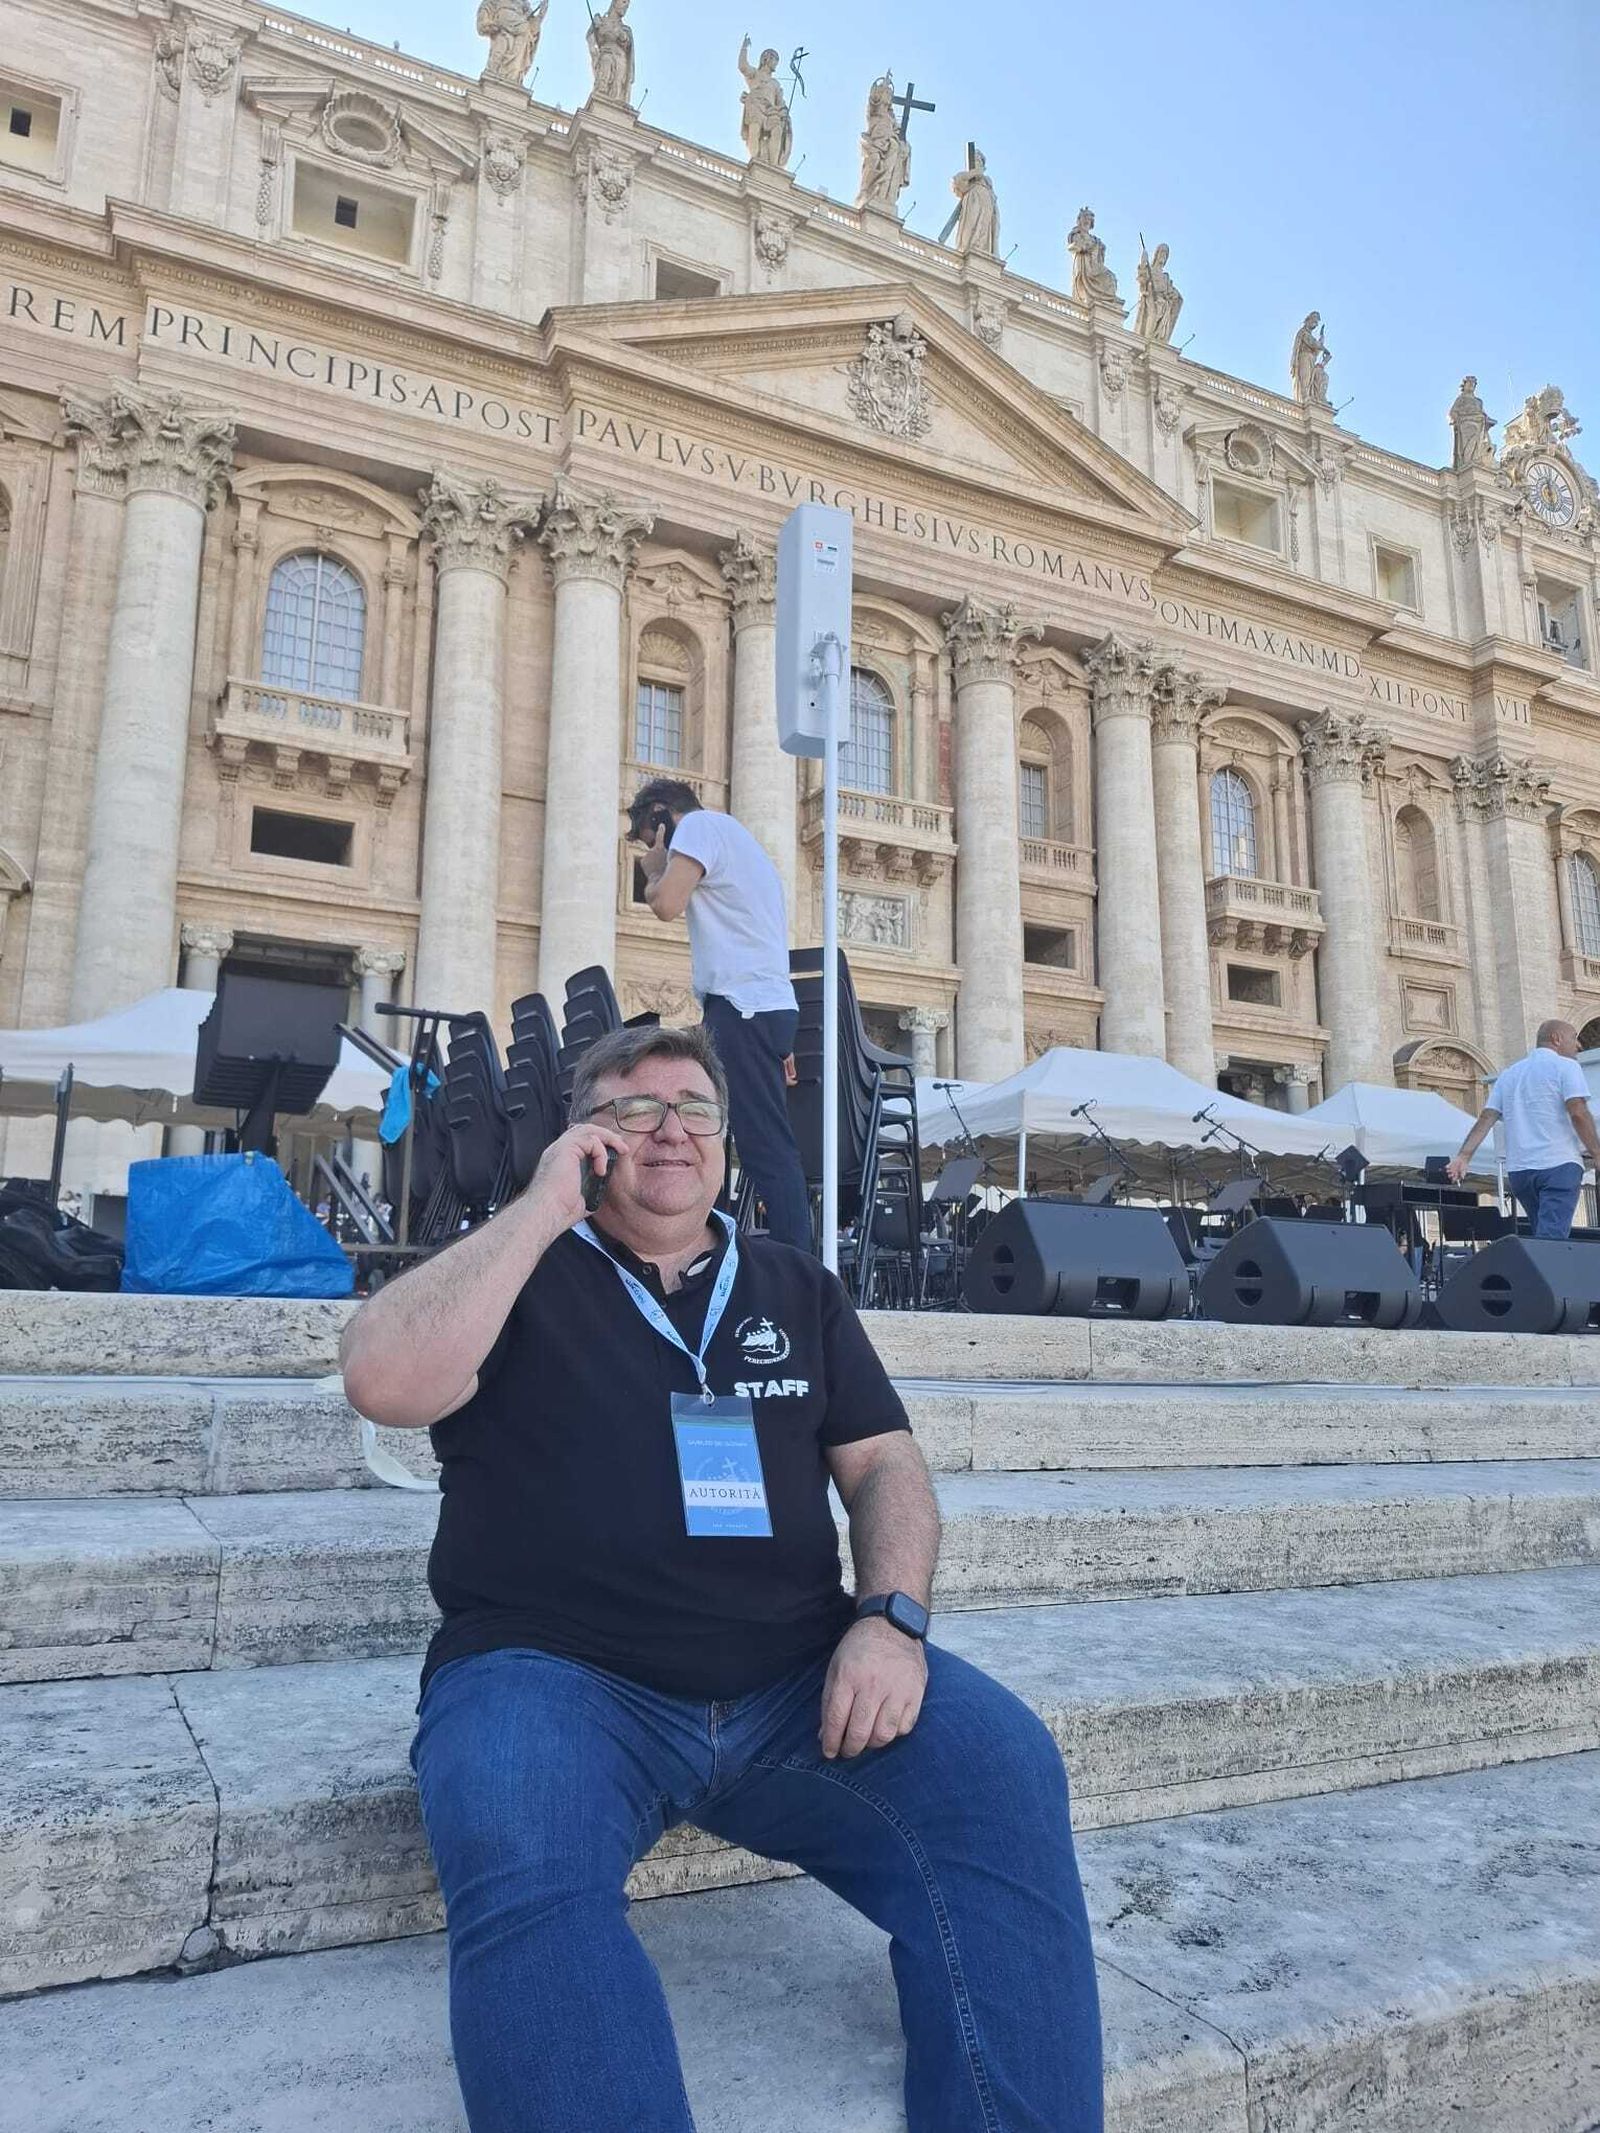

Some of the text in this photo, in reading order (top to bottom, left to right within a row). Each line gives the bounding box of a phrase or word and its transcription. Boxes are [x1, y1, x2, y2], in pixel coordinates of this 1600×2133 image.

[8, 284, 128, 347] REM
[1495, 695, 1529, 724] VII
[733, 1379, 809, 1399] STAFF
